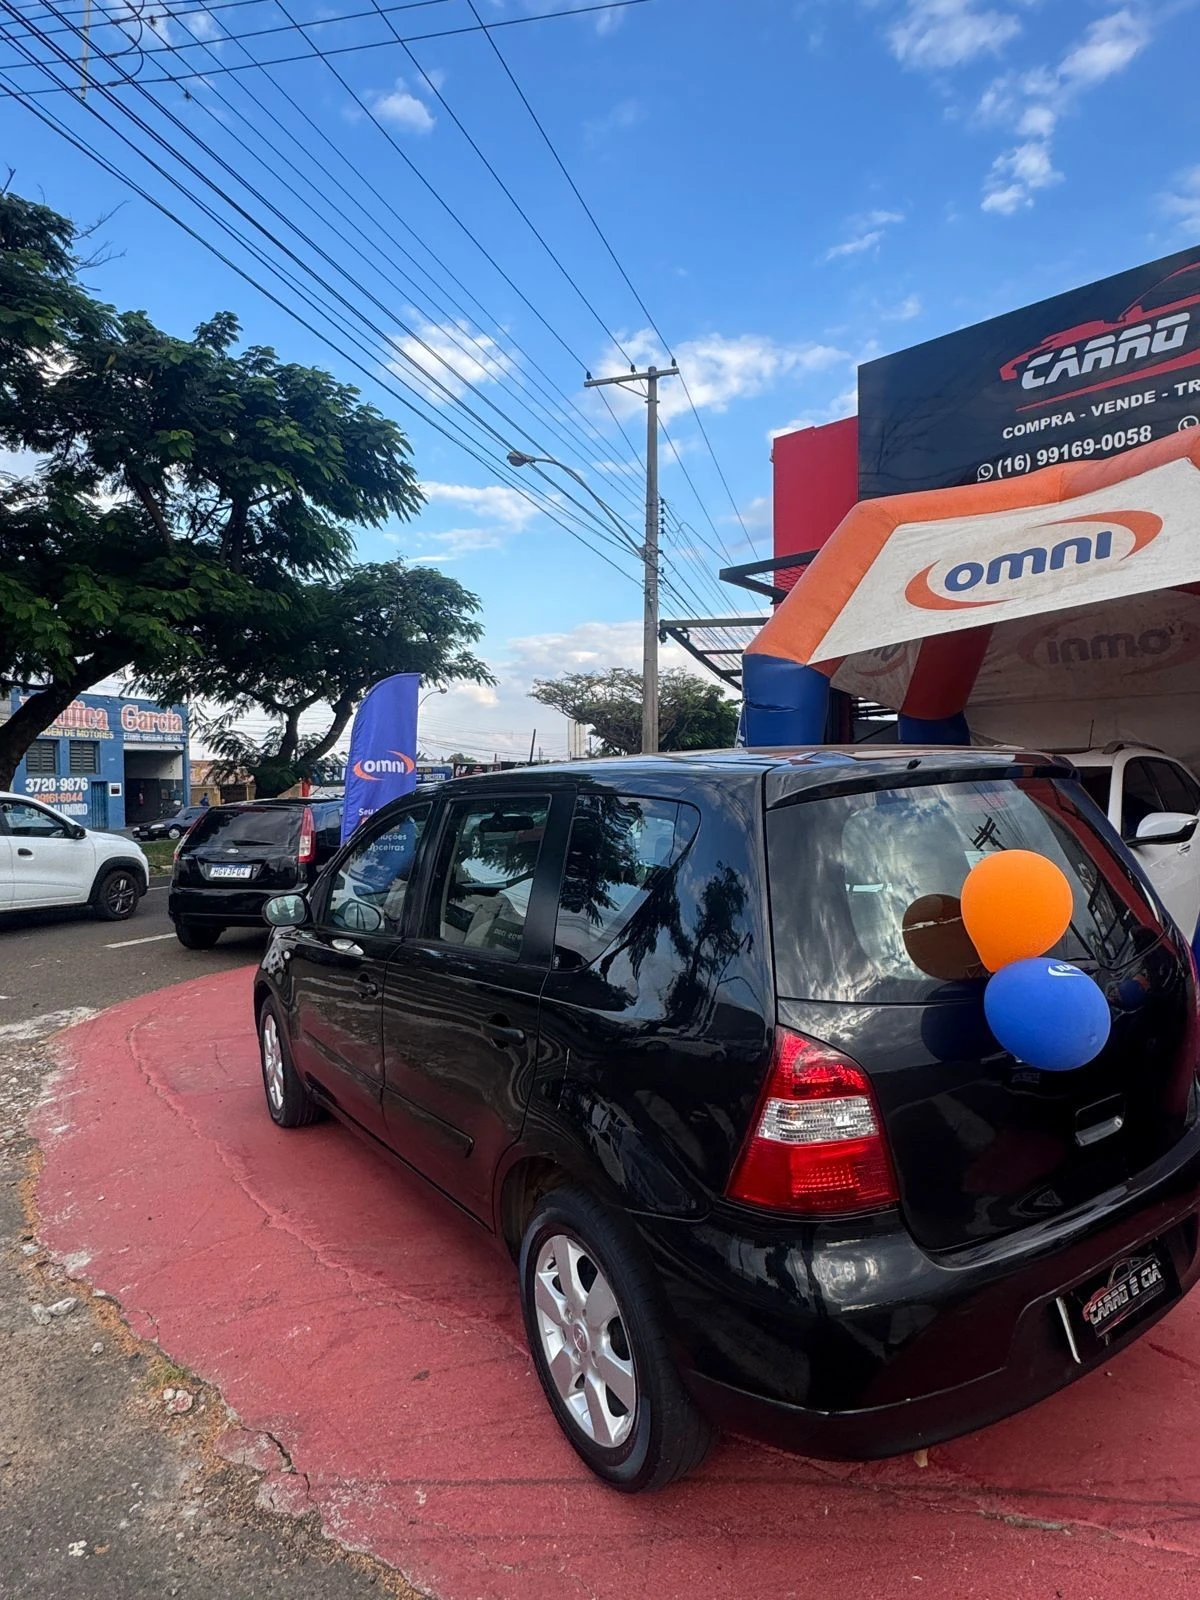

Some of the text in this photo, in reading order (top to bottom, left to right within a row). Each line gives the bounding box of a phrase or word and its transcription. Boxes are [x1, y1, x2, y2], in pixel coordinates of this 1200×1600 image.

[1021, 312, 1191, 390] CARRO
[1002, 411, 1075, 440] COMPRA
[1091, 390, 1156, 417] VENDE
[997, 425, 1152, 478] (16) 99169-0058
[944, 530, 1112, 592] omni
[77, 729, 114, 740] MOTORES
[121, 704, 183, 733] Garcia
[363, 760, 405, 773] omni
[358, 808, 374, 816] Seu
[1089, 1284, 1129, 1325] CARRO
[1129, 1276, 1140, 1296] E
[1140, 1263, 1162, 1288] CIA
